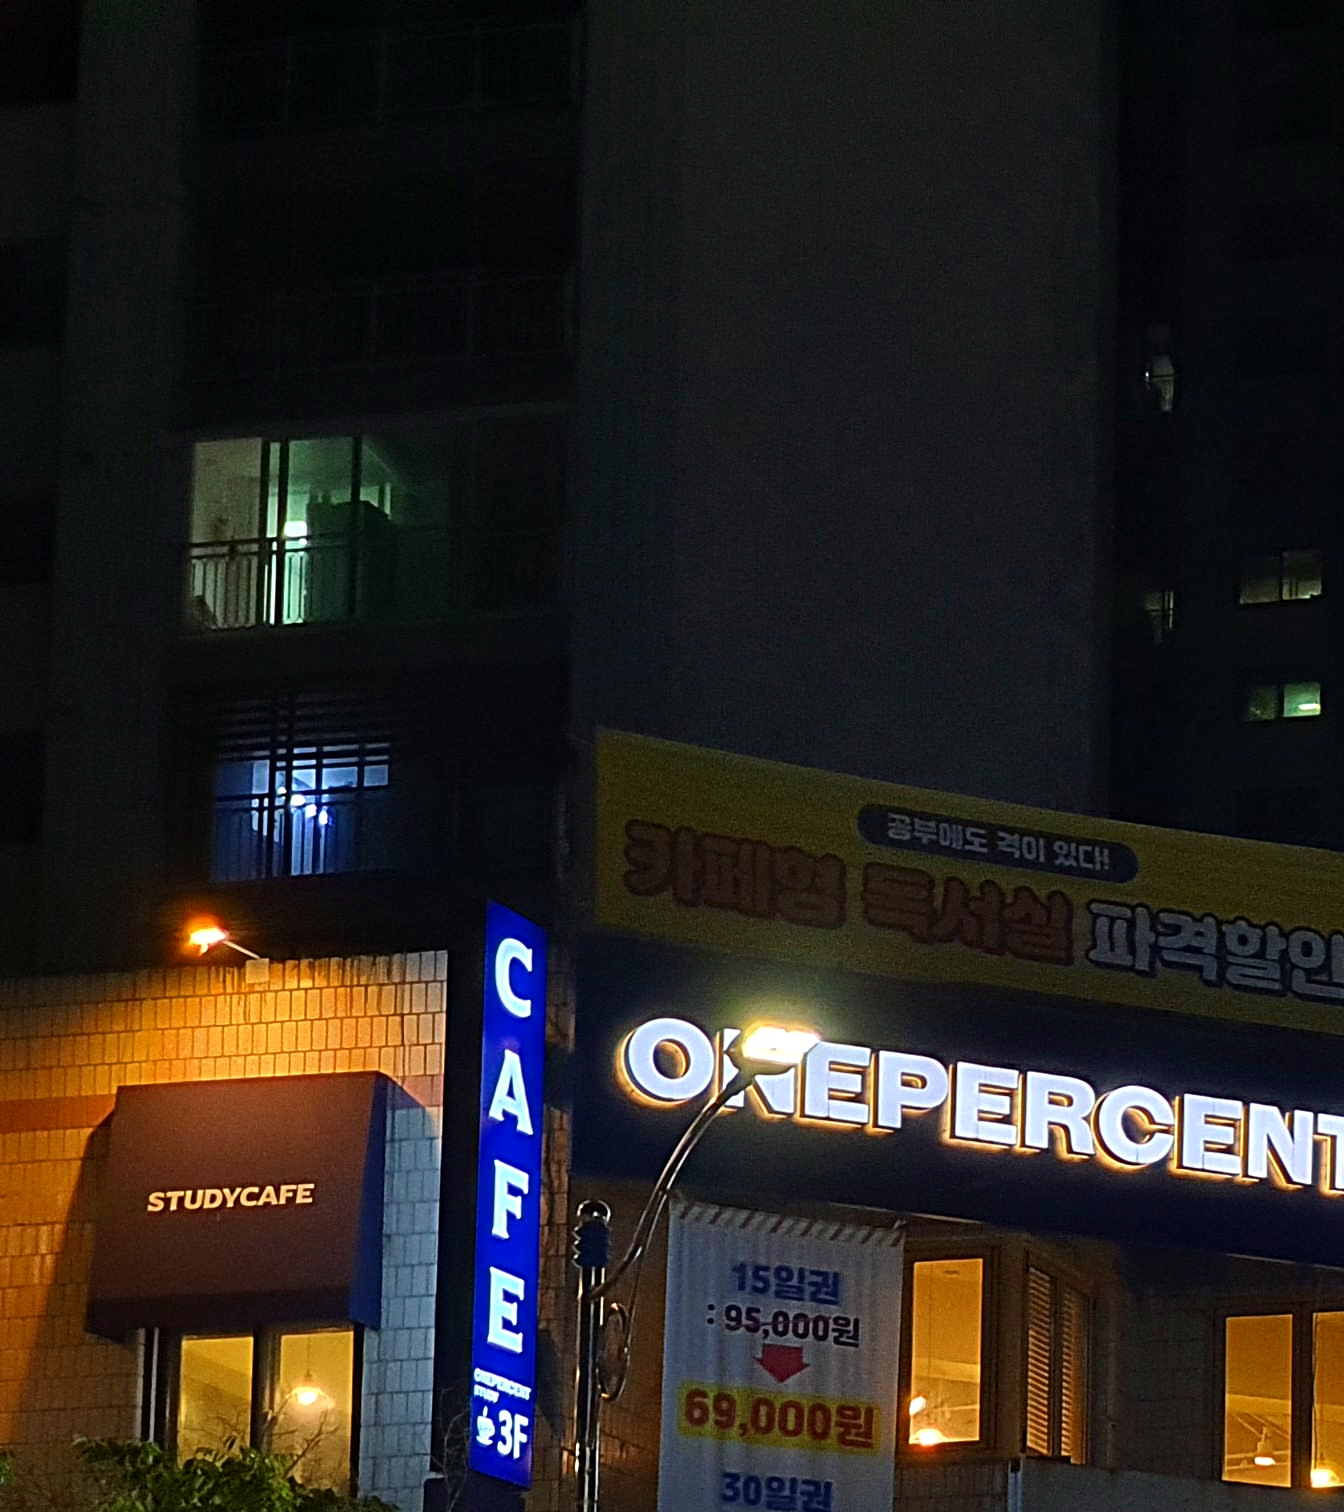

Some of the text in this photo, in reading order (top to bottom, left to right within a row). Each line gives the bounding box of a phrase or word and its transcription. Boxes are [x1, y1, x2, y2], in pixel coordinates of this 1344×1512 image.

[886, 812, 1110, 873] 공부에도 격이 있다!
[624, 820, 846, 928] 카페형
[861, 862, 1074, 965] 독서실
[487, 938, 533, 1354] CAFE
[147, 1183, 314, 1212] STUDYCAFE
[732, 1262, 839, 1306] 15일권
[497, 1409, 529, 1460] 3F
[684, 1388, 875, 1449] 69,000원
